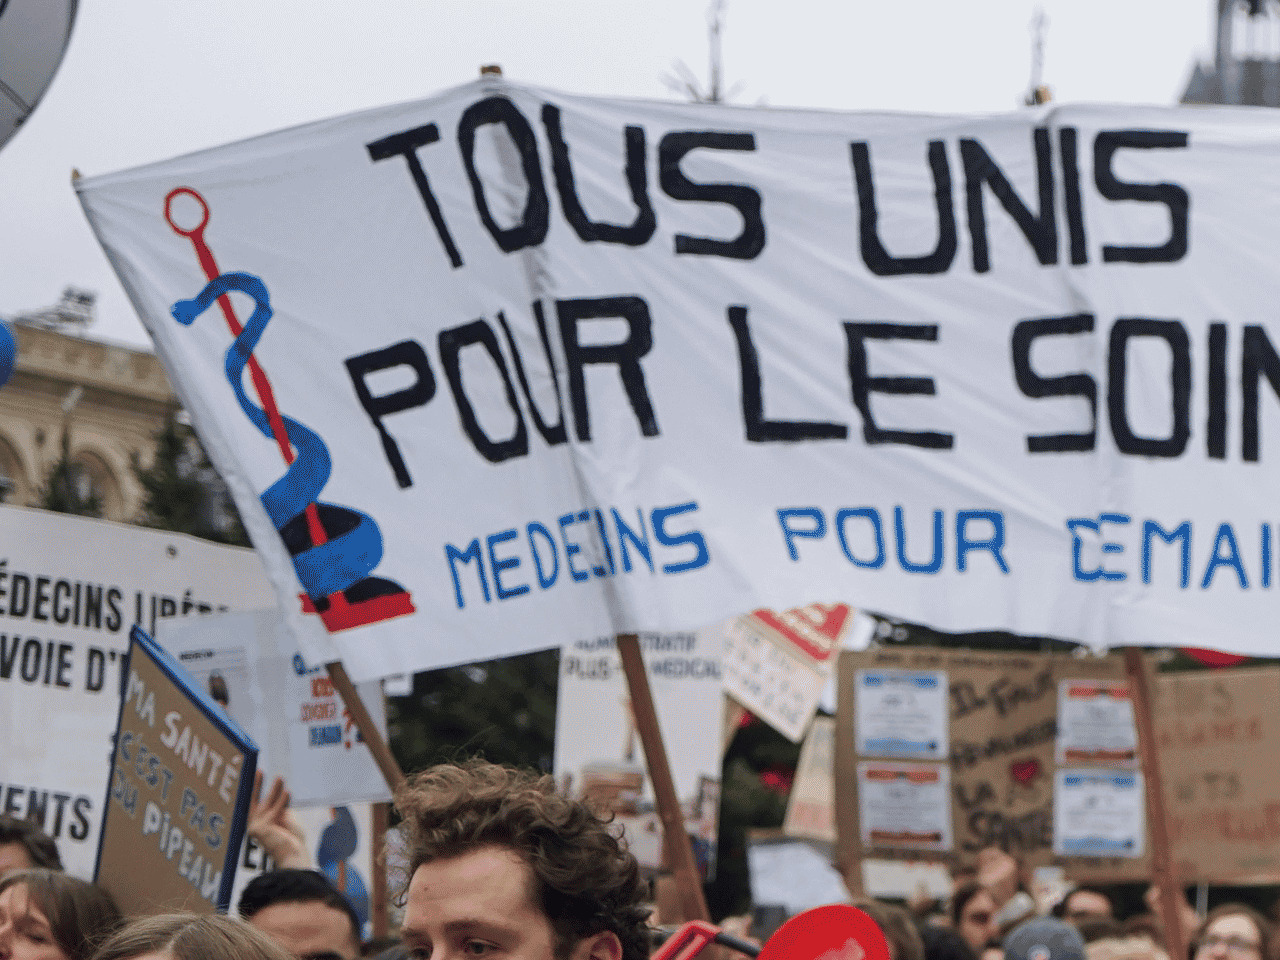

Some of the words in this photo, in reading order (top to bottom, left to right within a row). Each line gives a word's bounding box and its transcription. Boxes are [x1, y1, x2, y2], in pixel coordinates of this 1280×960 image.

[366, 96, 766, 269] TOUS
[850, 126, 1189, 276] UNIS
[345, 296, 661, 489] POUR
[728, 306, 953, 449] LE
[777, 505, 1010, 577] POUR
[120, 731, 174, 803] C'EST
[178, 786, 225, 850] PAS
[126, 671, 155, 726] MA
[161, 711, 242, 803] SANTÉ
[0, 786, 91, 841] ENTS
